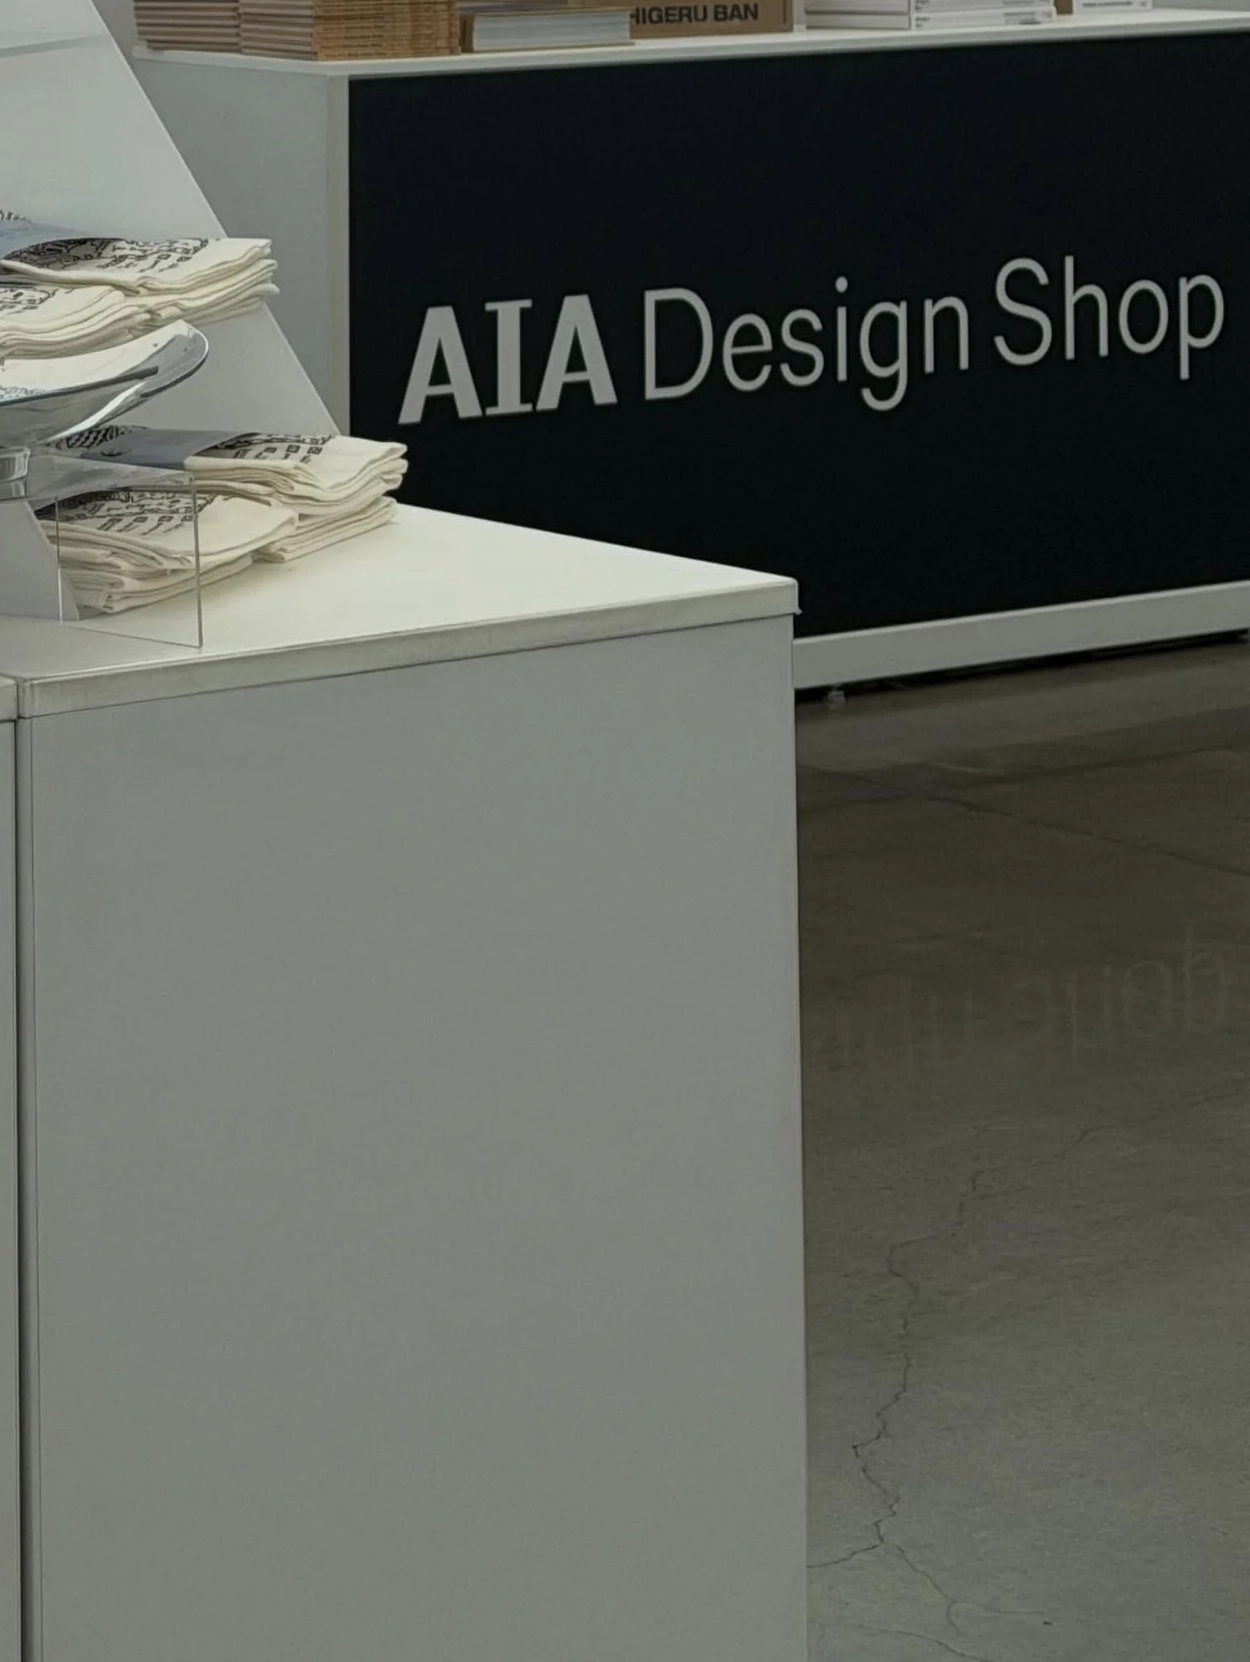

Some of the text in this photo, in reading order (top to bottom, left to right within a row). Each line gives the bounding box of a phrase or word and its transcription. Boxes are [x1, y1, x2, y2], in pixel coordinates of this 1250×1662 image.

[630, 3, 758, 25] HIGERU BAN
[398, 255, 1225, 424] AIA Design Shop
